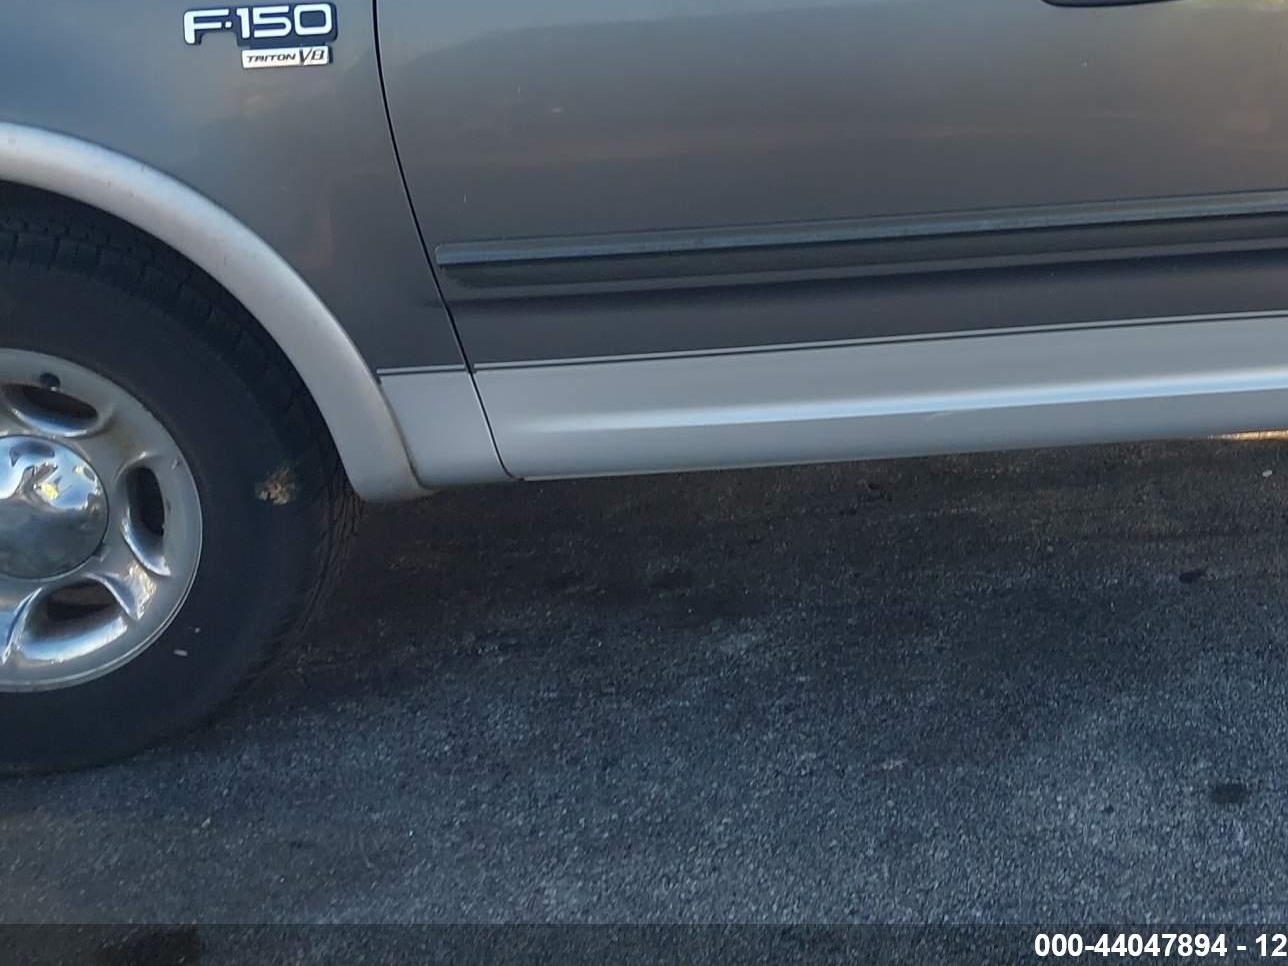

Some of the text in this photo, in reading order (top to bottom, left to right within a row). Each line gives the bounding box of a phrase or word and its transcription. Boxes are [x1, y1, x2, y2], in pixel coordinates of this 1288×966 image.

[183, 3, 334, 45] F-150
[246, 48, 325, 63] TRITON V8
